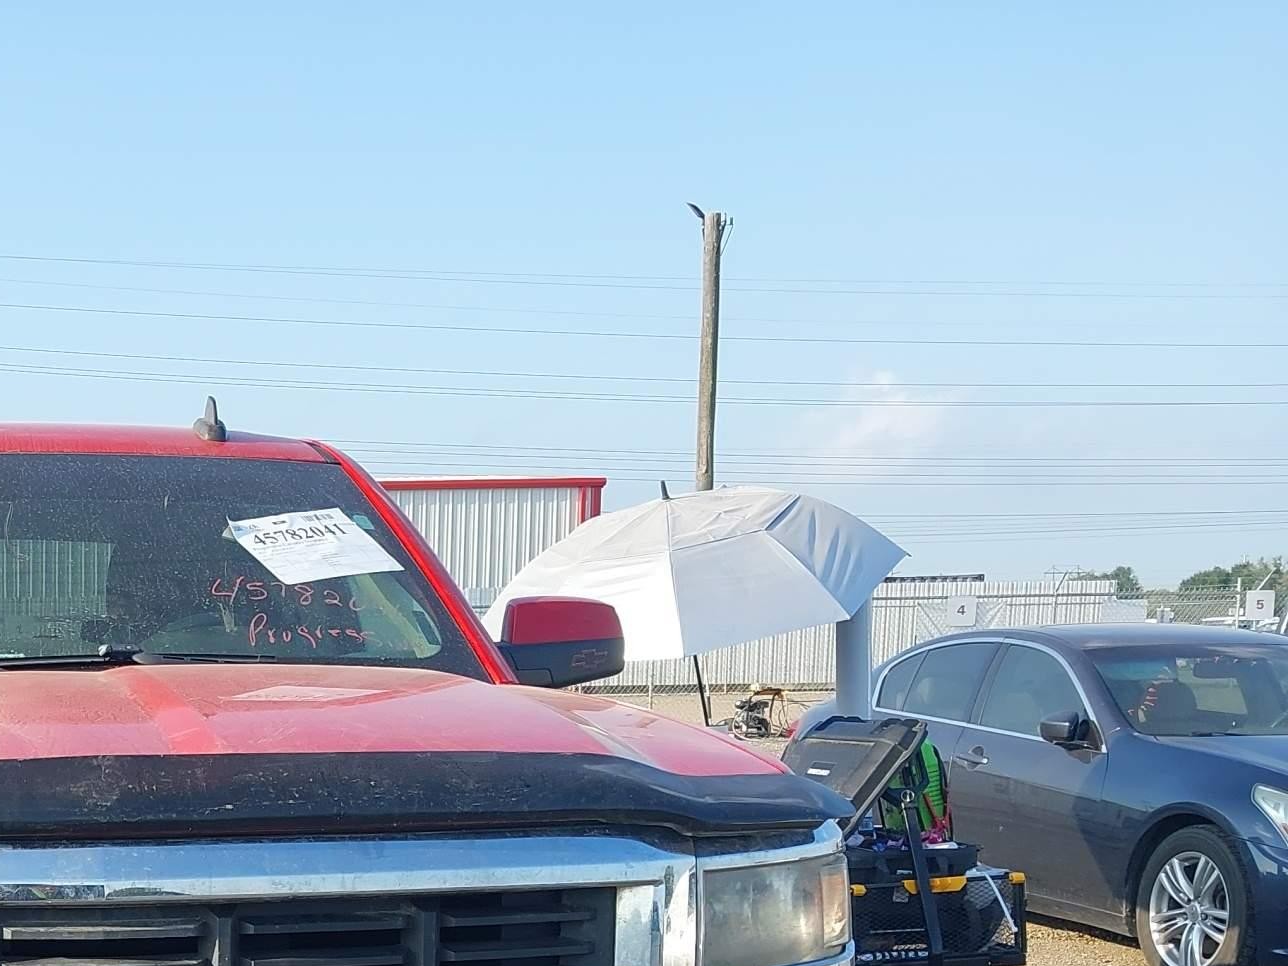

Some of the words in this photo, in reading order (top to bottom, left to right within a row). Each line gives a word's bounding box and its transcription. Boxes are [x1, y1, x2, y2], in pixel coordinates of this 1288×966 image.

[253, 523, 348, 545] 45782041
[956, 604, 967, 616] 4
[1256, 599, 1265, 610] 5
